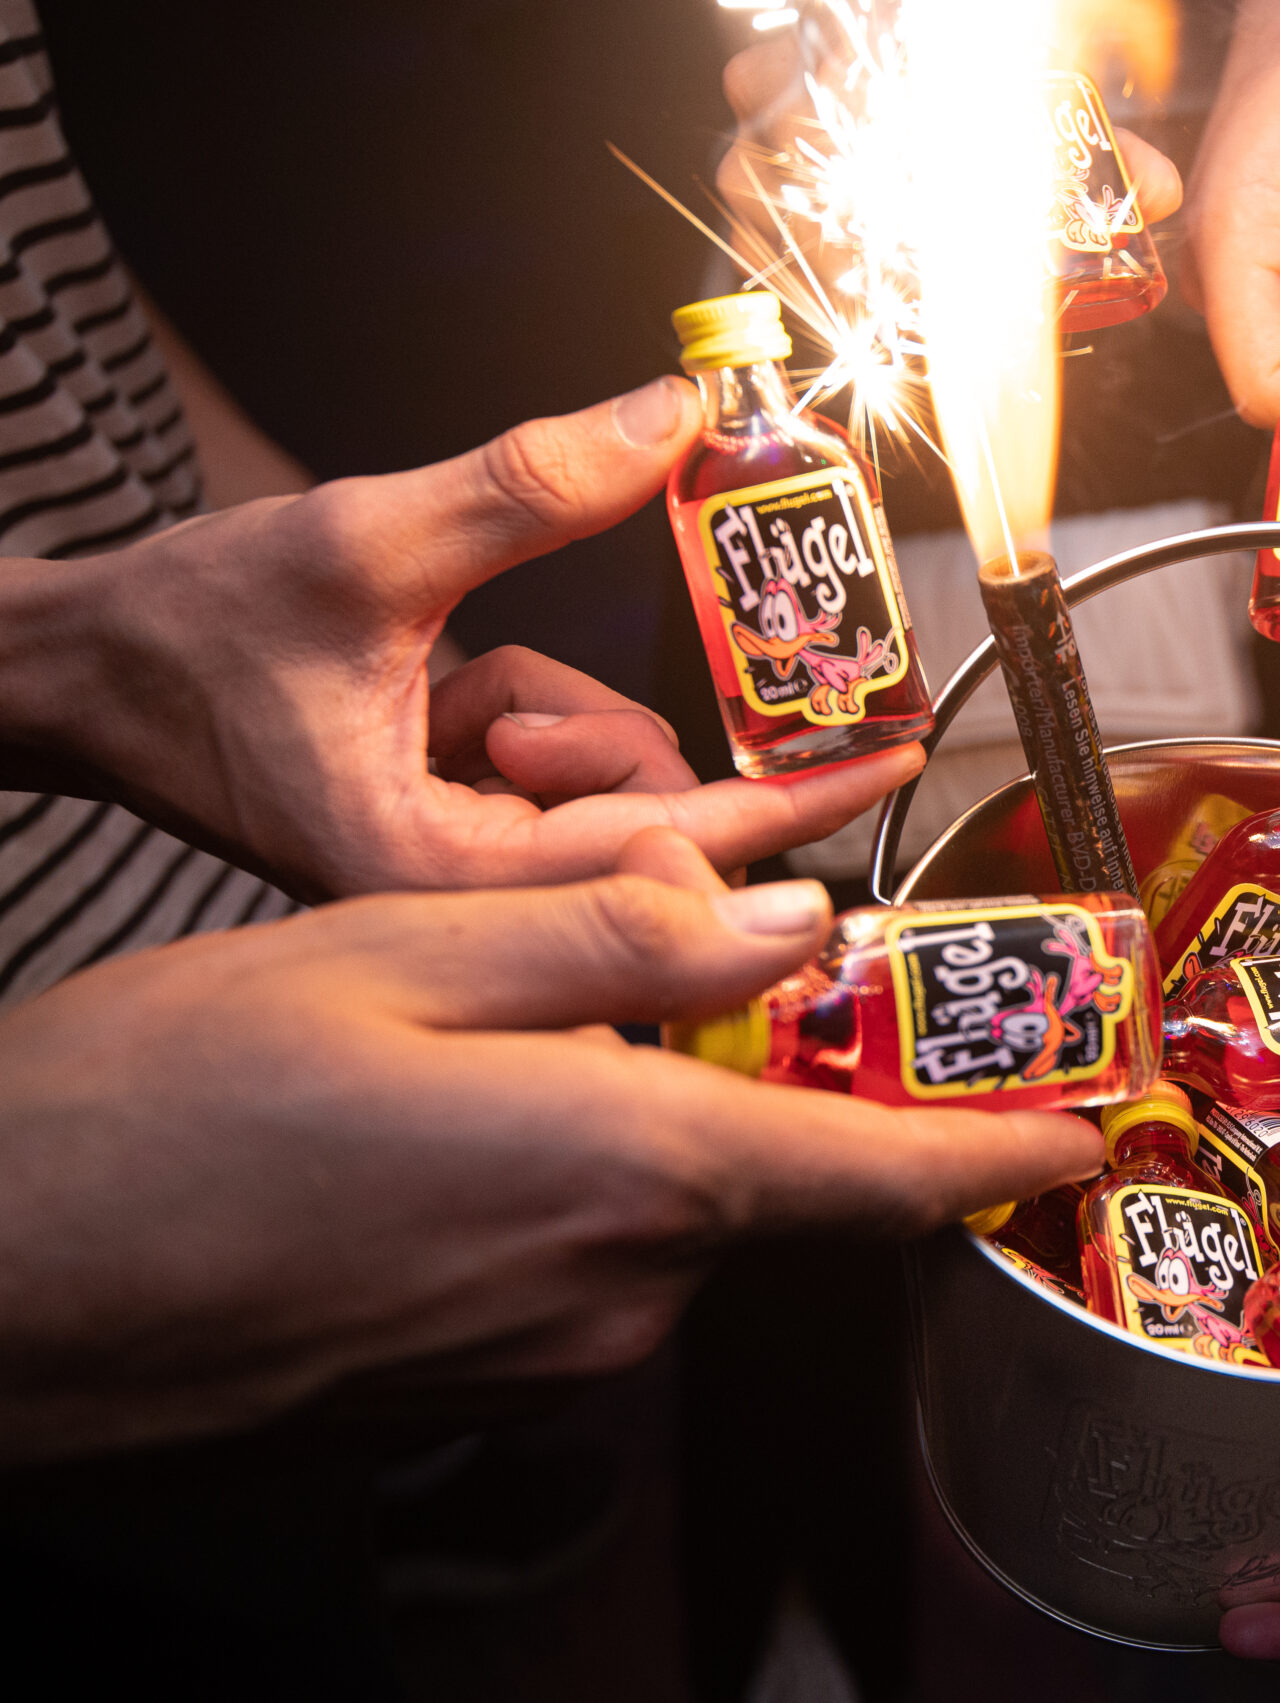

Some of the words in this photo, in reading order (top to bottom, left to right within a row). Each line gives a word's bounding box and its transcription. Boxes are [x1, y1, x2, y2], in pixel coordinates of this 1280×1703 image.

[1053, 79, 1113, 170] gel
[714, 478, 876, 614] Flügel
[1062, 678, 1083, 728] Lesen
[1074, 729, 1090, 756] Sie
[1081, 756, 1108, 826] hinweise
[1100, 828, 1119, 854] auf
[898, 922, 1031, 1084] Flügel
[1125, 1191, 1258, 1289] Flügel
[1165, 1197, 1229, 1216] www.flugel.com
